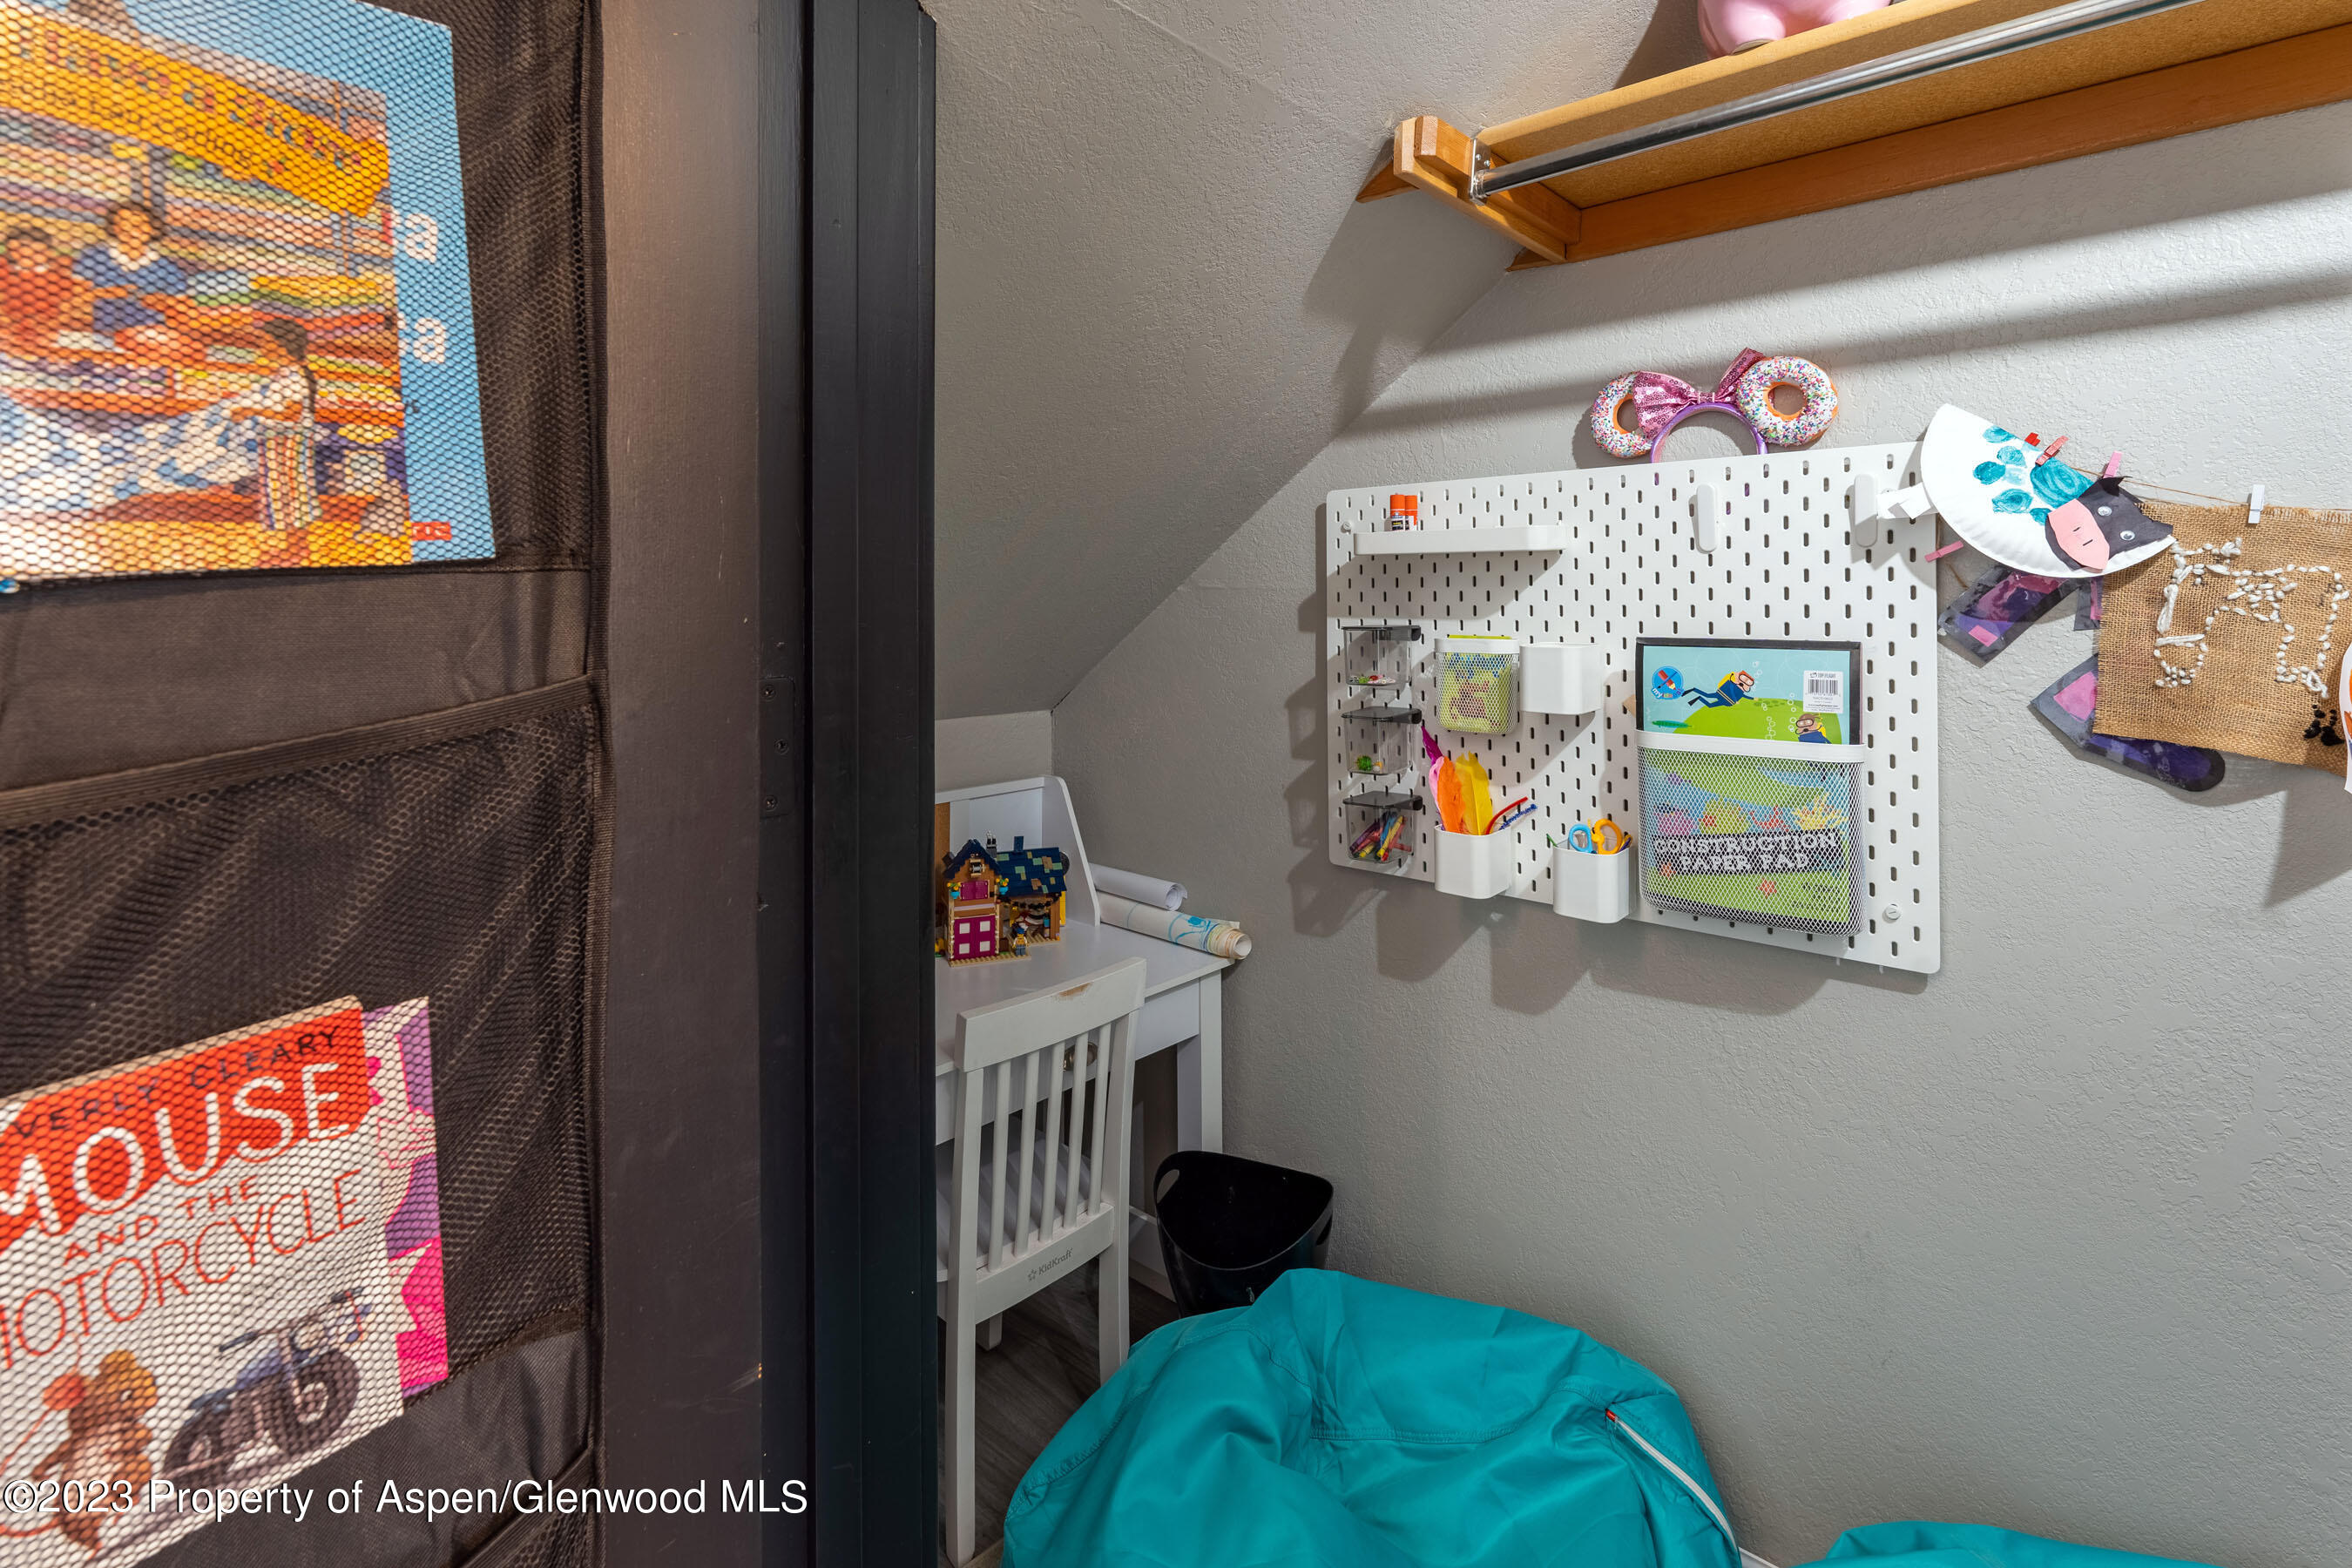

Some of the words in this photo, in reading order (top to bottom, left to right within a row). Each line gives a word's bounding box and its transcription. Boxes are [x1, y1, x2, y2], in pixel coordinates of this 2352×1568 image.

[1655, 834, 1837, 854] CONSTRUCTION
[1680, 855, 1751, 872] PAPER
[1761, 853, 1809, 871] PAD
[190, 1025, 341, 1090] CLEARY
[64, 1214, 159, 1265] AND
[178, 1175, 260, 1220] THE
[0, 1169, 366, 1369] OTORCYCLE
[1038, 1248, 1071, 1275] KidKraft
